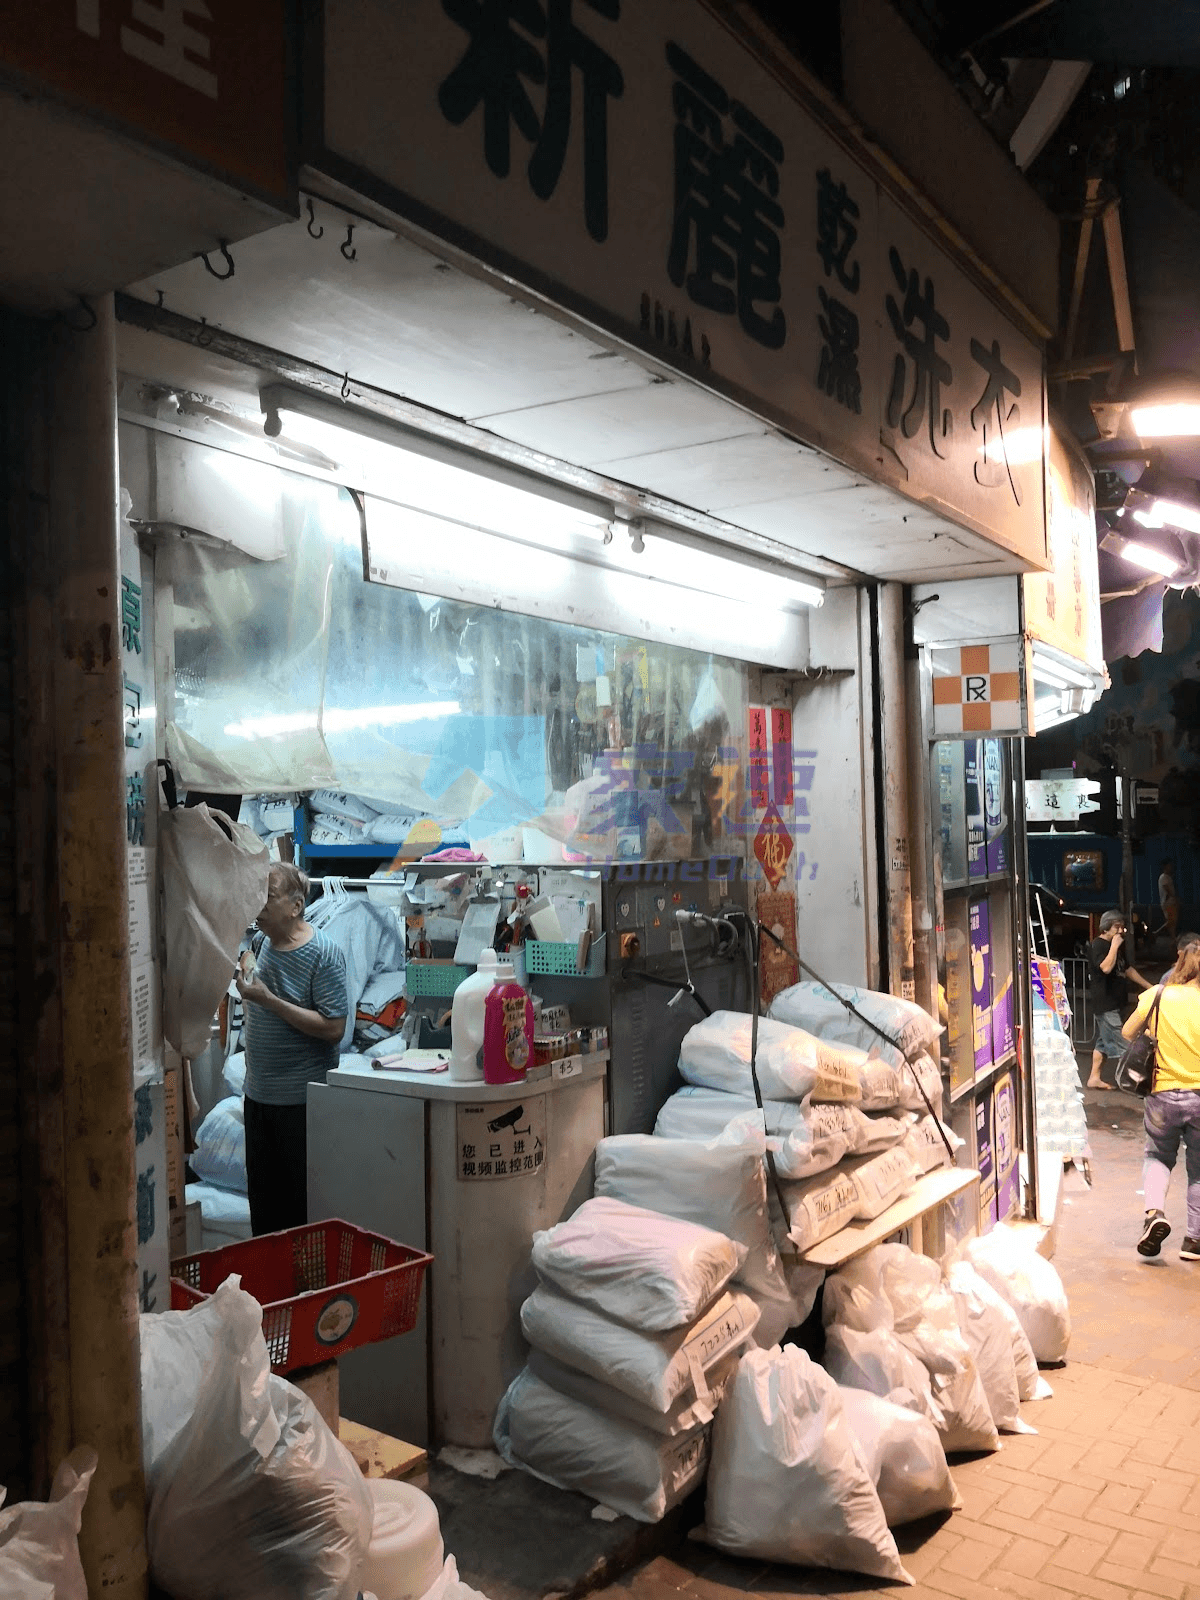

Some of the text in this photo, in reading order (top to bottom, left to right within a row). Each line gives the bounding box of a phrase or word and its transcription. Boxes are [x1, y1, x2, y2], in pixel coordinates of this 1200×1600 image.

[559, 1060, 574, 1075] $3
[462, 1135, 543, 1159] 您已进入
[462, 1151, 544, 1176] 视频监控范围
